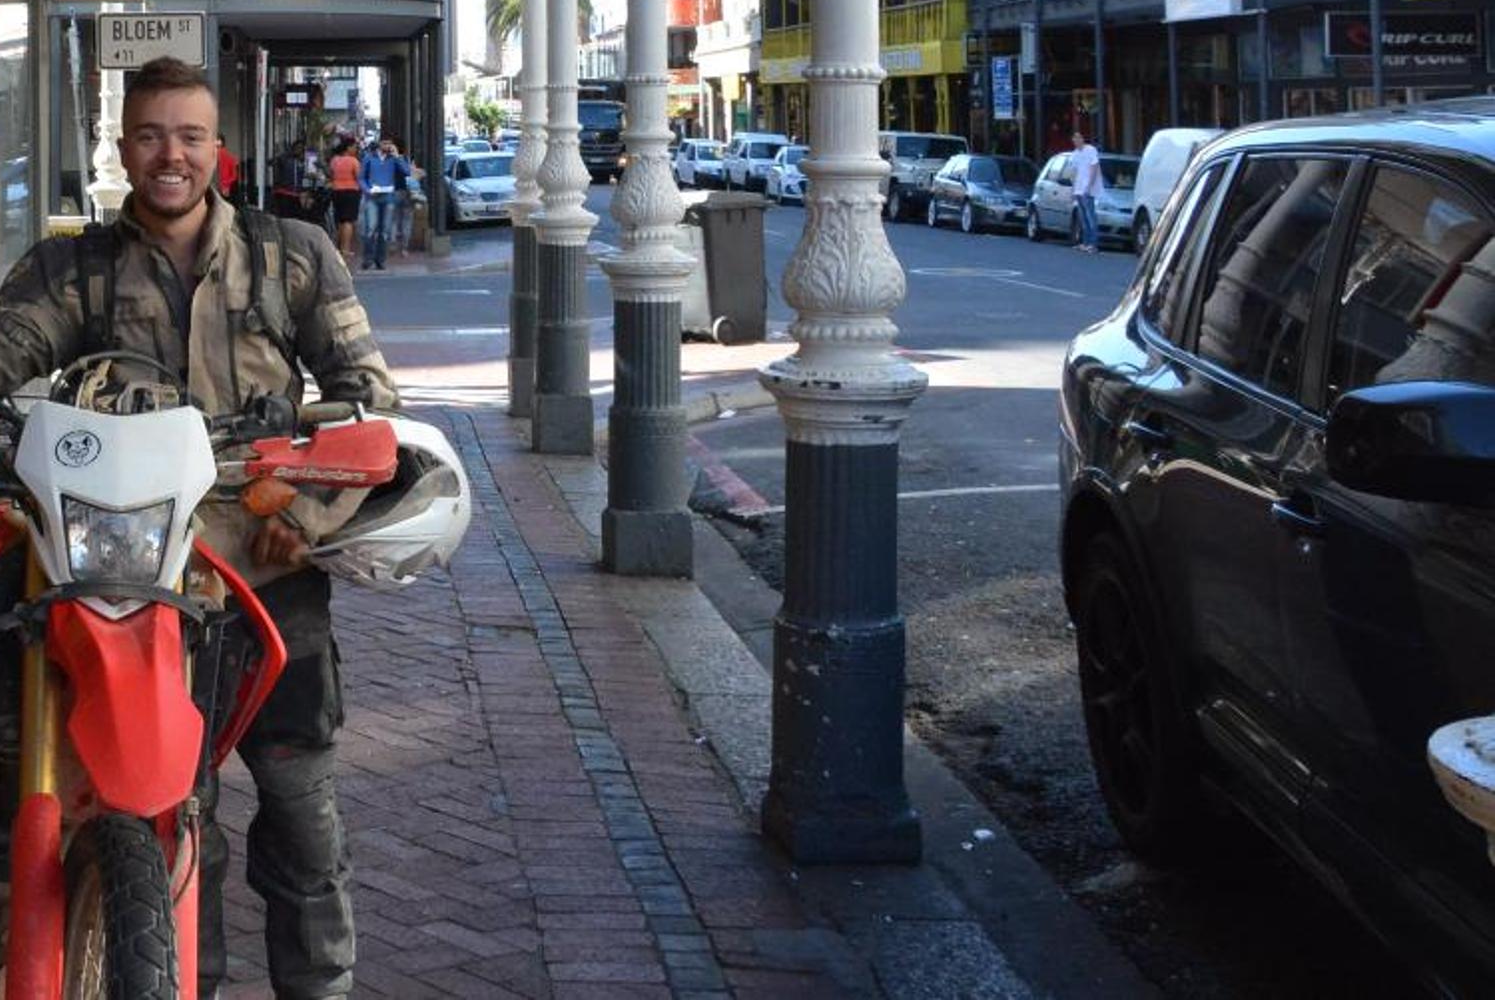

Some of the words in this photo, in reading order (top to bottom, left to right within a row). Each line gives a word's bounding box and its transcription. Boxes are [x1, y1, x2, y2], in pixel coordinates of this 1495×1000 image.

[112, 20, 172, 41] BLOEM
[178, 19, 191, 32] ST
[1380, 33, 1418, 44] RIP
[1419, 32, 1474, 44] CURL
